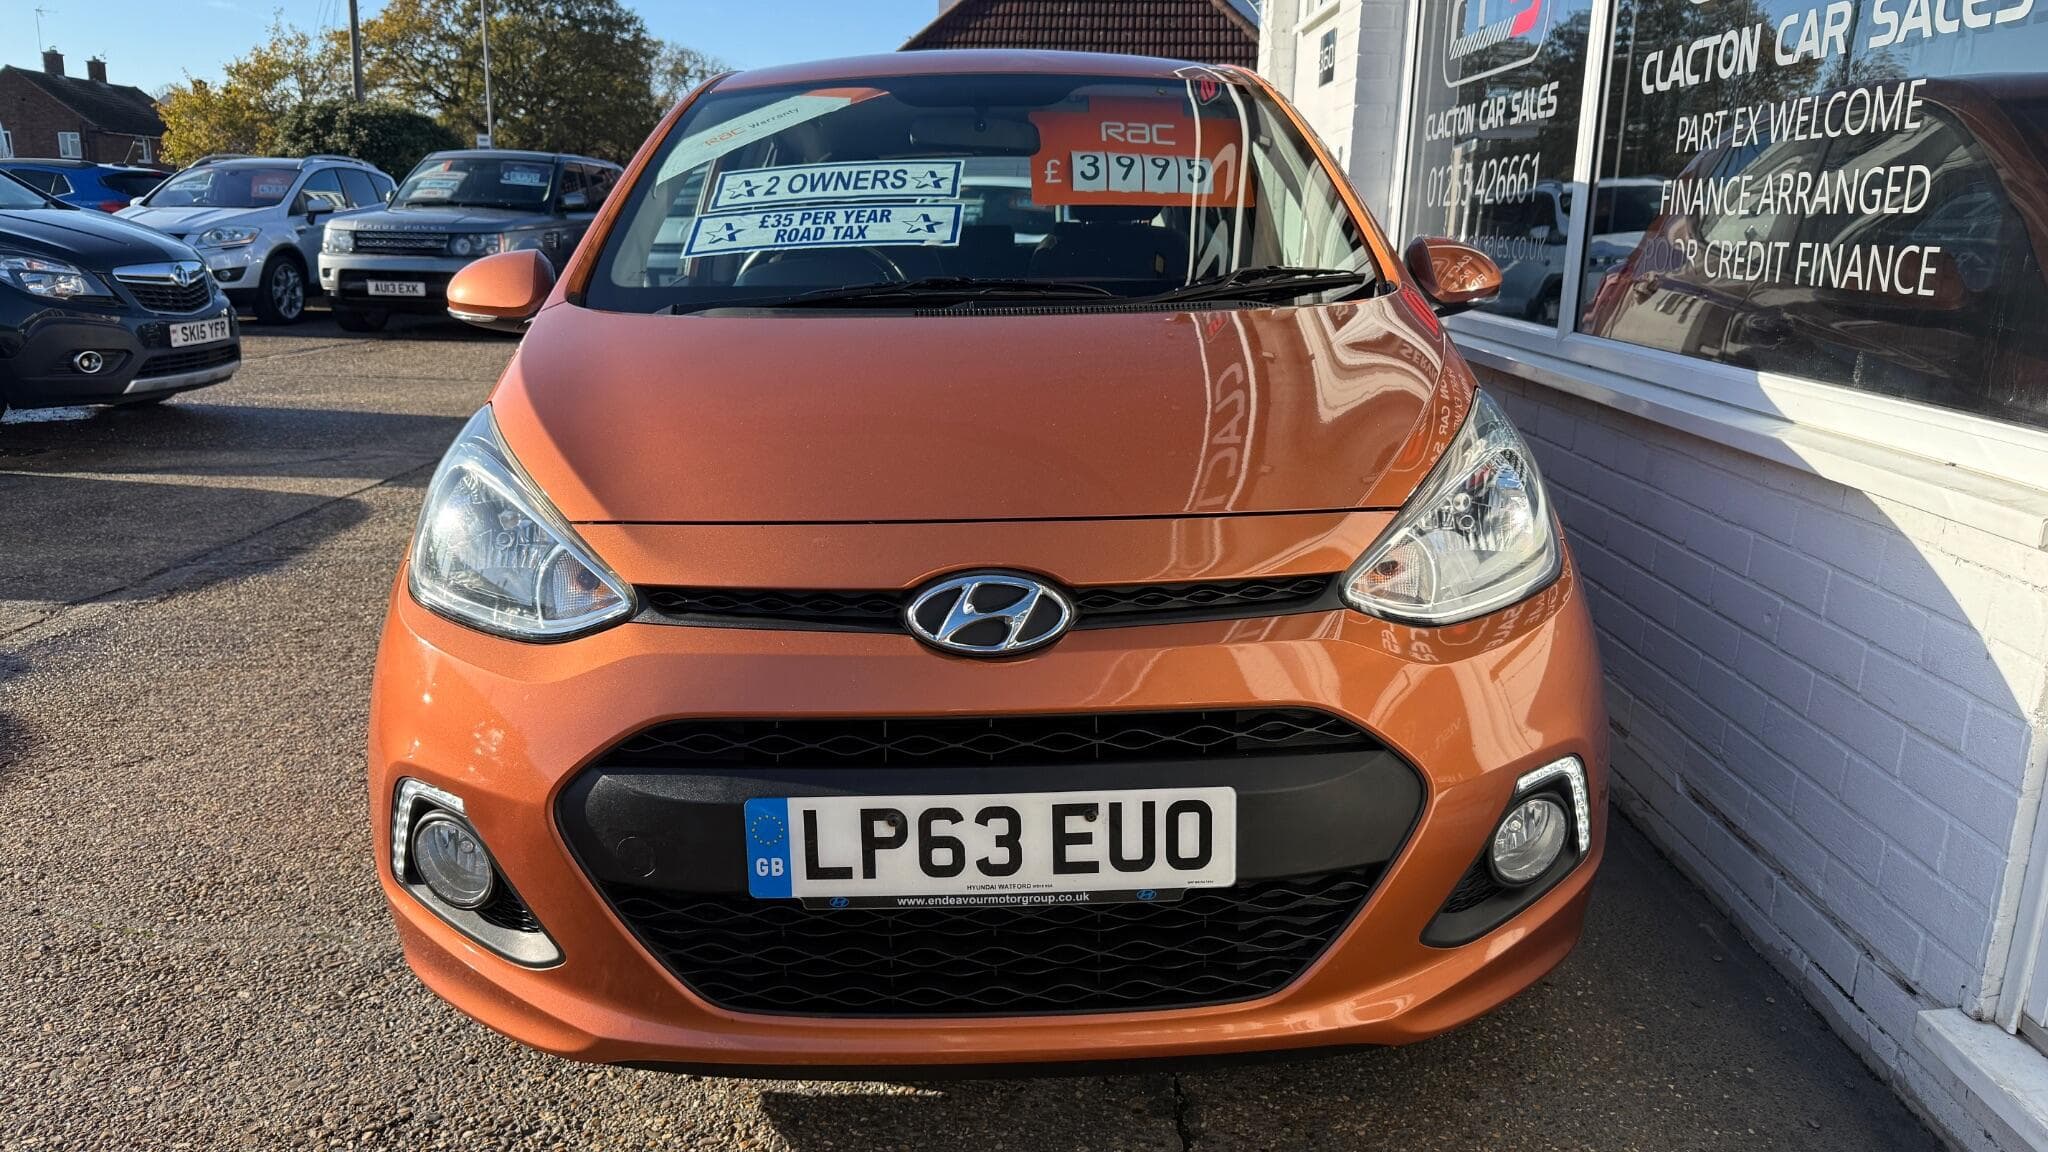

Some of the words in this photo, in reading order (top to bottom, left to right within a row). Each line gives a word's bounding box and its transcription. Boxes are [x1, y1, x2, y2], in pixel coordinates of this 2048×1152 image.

[1641, 23, 1762, 95] CLACTON
[1775, 0, 1853, 66] CAR
[748, 107, 800, 128] Warranty
[1425, 103, 1476, 142] CLACTON
[1479, 96, 1506, 131] CAR
[1510, 81, 1559, 126] SALES
[1675, 110, 1728, 154] PART
[1732, 104, 1763, 148] EX
[1769, 79, 1927, 144] WELCOME
[763, 174, 780, 197] 2
[787, 168, 908, 195] OWNERS
[1044, 159, 1062, 184] £
[1079, 154, 1207, 184] 3995
[1475, 151, 1540, 205] 426661
[1659, 174, 1754, 216] FINANCE
[1756, 164, 1932, 216] ARRANGED
[758, 213, 793, 230] £35
[800, 211, 836, 226] PER
[842, 209, 891, 224] YEAR
[774, 226, 826, 243] ROAD
[833, 224, 868, 240] TAX
[1703, 239, 1790, 284] CREDIT
[1794, 242, 1941, 297] FINANCE
[374, 282, 396, 293] AU13
[398, 282, 419, 294] EXK
[181, 325, 206, 342] SK15
[207, 321, 226, 338] YFR
[803, 805, 1023, 881] LP63
[1051, 799, 1214, 875] EUO
[755, 857, 784, 878] GB
[897, 891, 1090, 906] www.endeavourmotorgroup.co.uk
